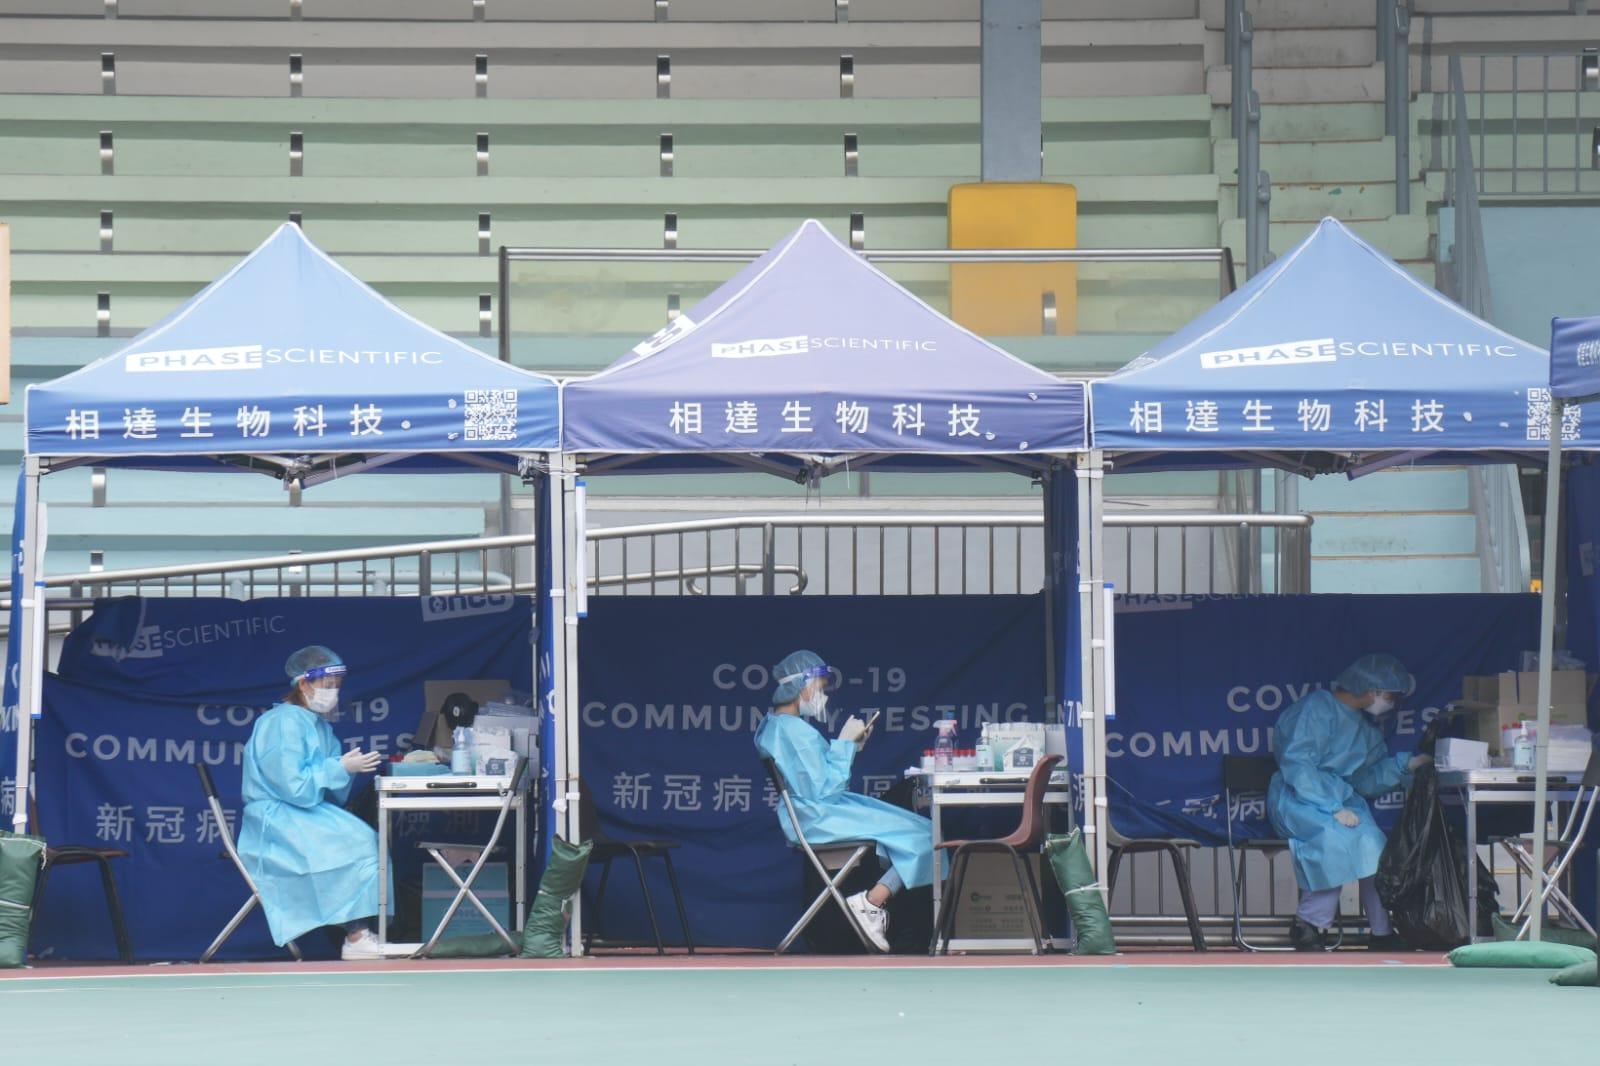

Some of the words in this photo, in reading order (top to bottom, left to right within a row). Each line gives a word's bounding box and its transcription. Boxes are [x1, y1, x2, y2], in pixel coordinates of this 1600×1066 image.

[138, 350, 262, 368] PHASE
[265, 347, 444, 366] SCIENTIFIC
[810, 336, 938, 352] SCIENTIFIC
[1213, 343, 1336, 365] PHASE
[1339, 341, 1518, 358] SCIENTIFIC
[65, 403, 384, 440] 相達生物科技
[669, 400, 981, 438] 相達生物科技
[1128, 399, 1445, 434] 相達生物科技
[163, 616, 287, 649] SCIENTIFIC
